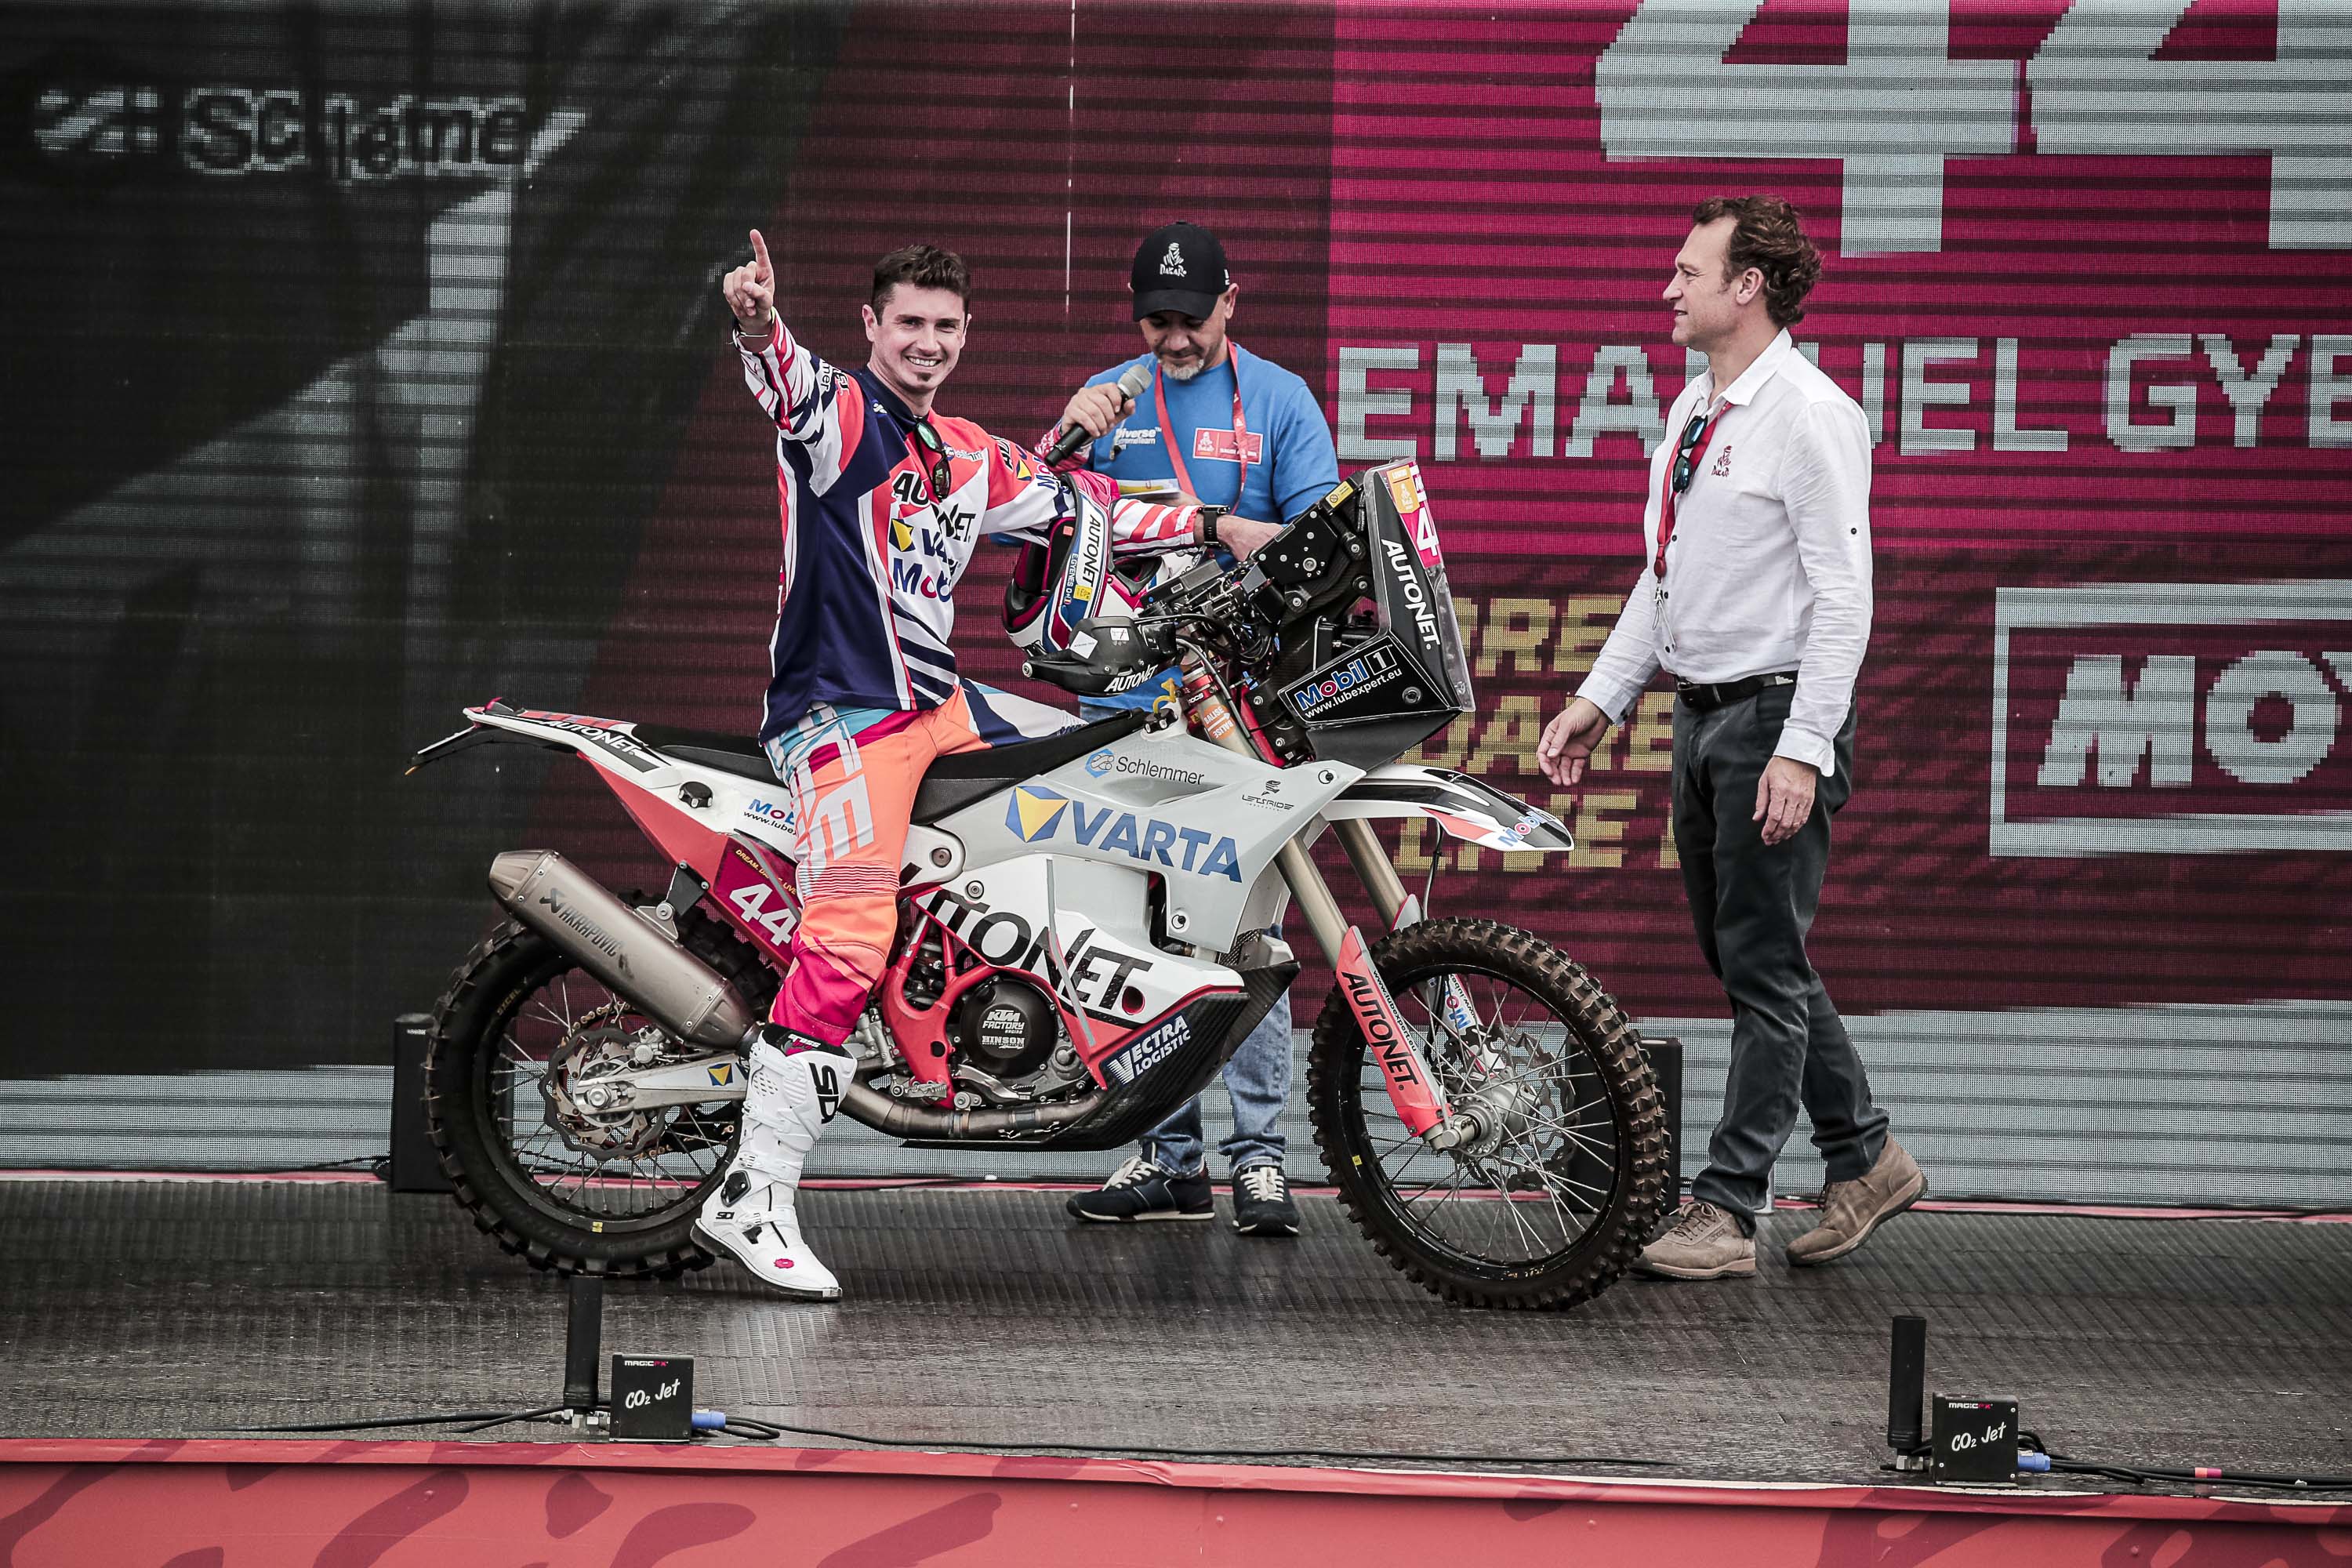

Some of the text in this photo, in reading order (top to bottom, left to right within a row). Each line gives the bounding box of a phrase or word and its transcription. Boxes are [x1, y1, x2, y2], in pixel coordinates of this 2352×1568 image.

[1595, 0, 2352, 257] 44
[1160, 263, 1188, 277] DAKAR
[1082, 514, 1101, 588] AUTONET
[1381, 539, 1441, 646] AUTONET
[1104, 664, 1159, 692] AUTONET
[1294, 659, 1370, 711] Mobil
[1305, 666, 1403, 719] www.lubexpert.eu
[1203, 706, 1225, 725] BALISE
[1212, 719, 1235, 739] BALISE
[2037, 650, 2352, 788] MO
[540, 720, 643, 756] AUTONET
[1116, 756, 1204, 785] Schlemmer
[735, 849, 760, 871] DREAM.
[1073, 800, 1243, 884] VARTA
[729, 883, 797, 947] 44
[982, 1021, 1025, 1030] FACTORY
[987, 1009, 1021, 1022] KTM
[1341, 971, 1418, 1085] AUTONET
[1372, 969, 1417, 1052] www.lubexpert.eu
[982, 1036, 1025, 1045] HINSON
[1106, 1016, 1188, 1086] VECTRA
[1135, 1029, 1192, 1076] LOGISTIC
[655, 1378, 681, 1400] Jet
[1980, 1421, 2007, 1443] Jet
